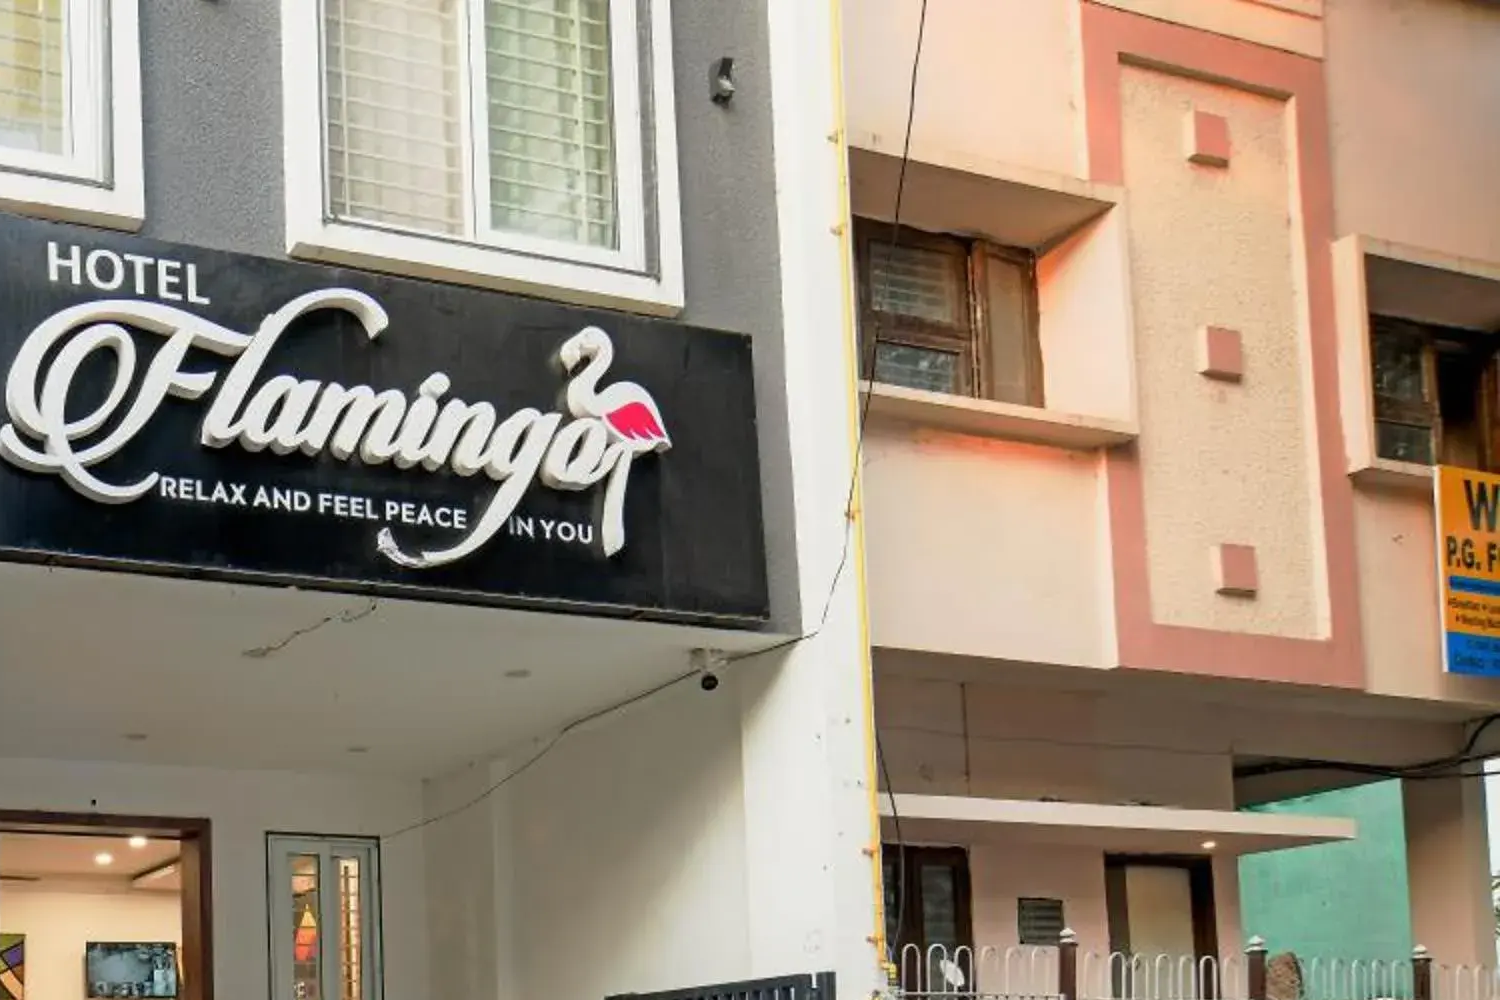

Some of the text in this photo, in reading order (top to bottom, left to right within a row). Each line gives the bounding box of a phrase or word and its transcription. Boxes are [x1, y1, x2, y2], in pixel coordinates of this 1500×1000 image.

[47, 241, 210, 306] HOTEL
[160, 476, 594, 544] RELAX AND FEEL PEACE IN YOU
[1446, 535, 1500, 573] P.G. F
